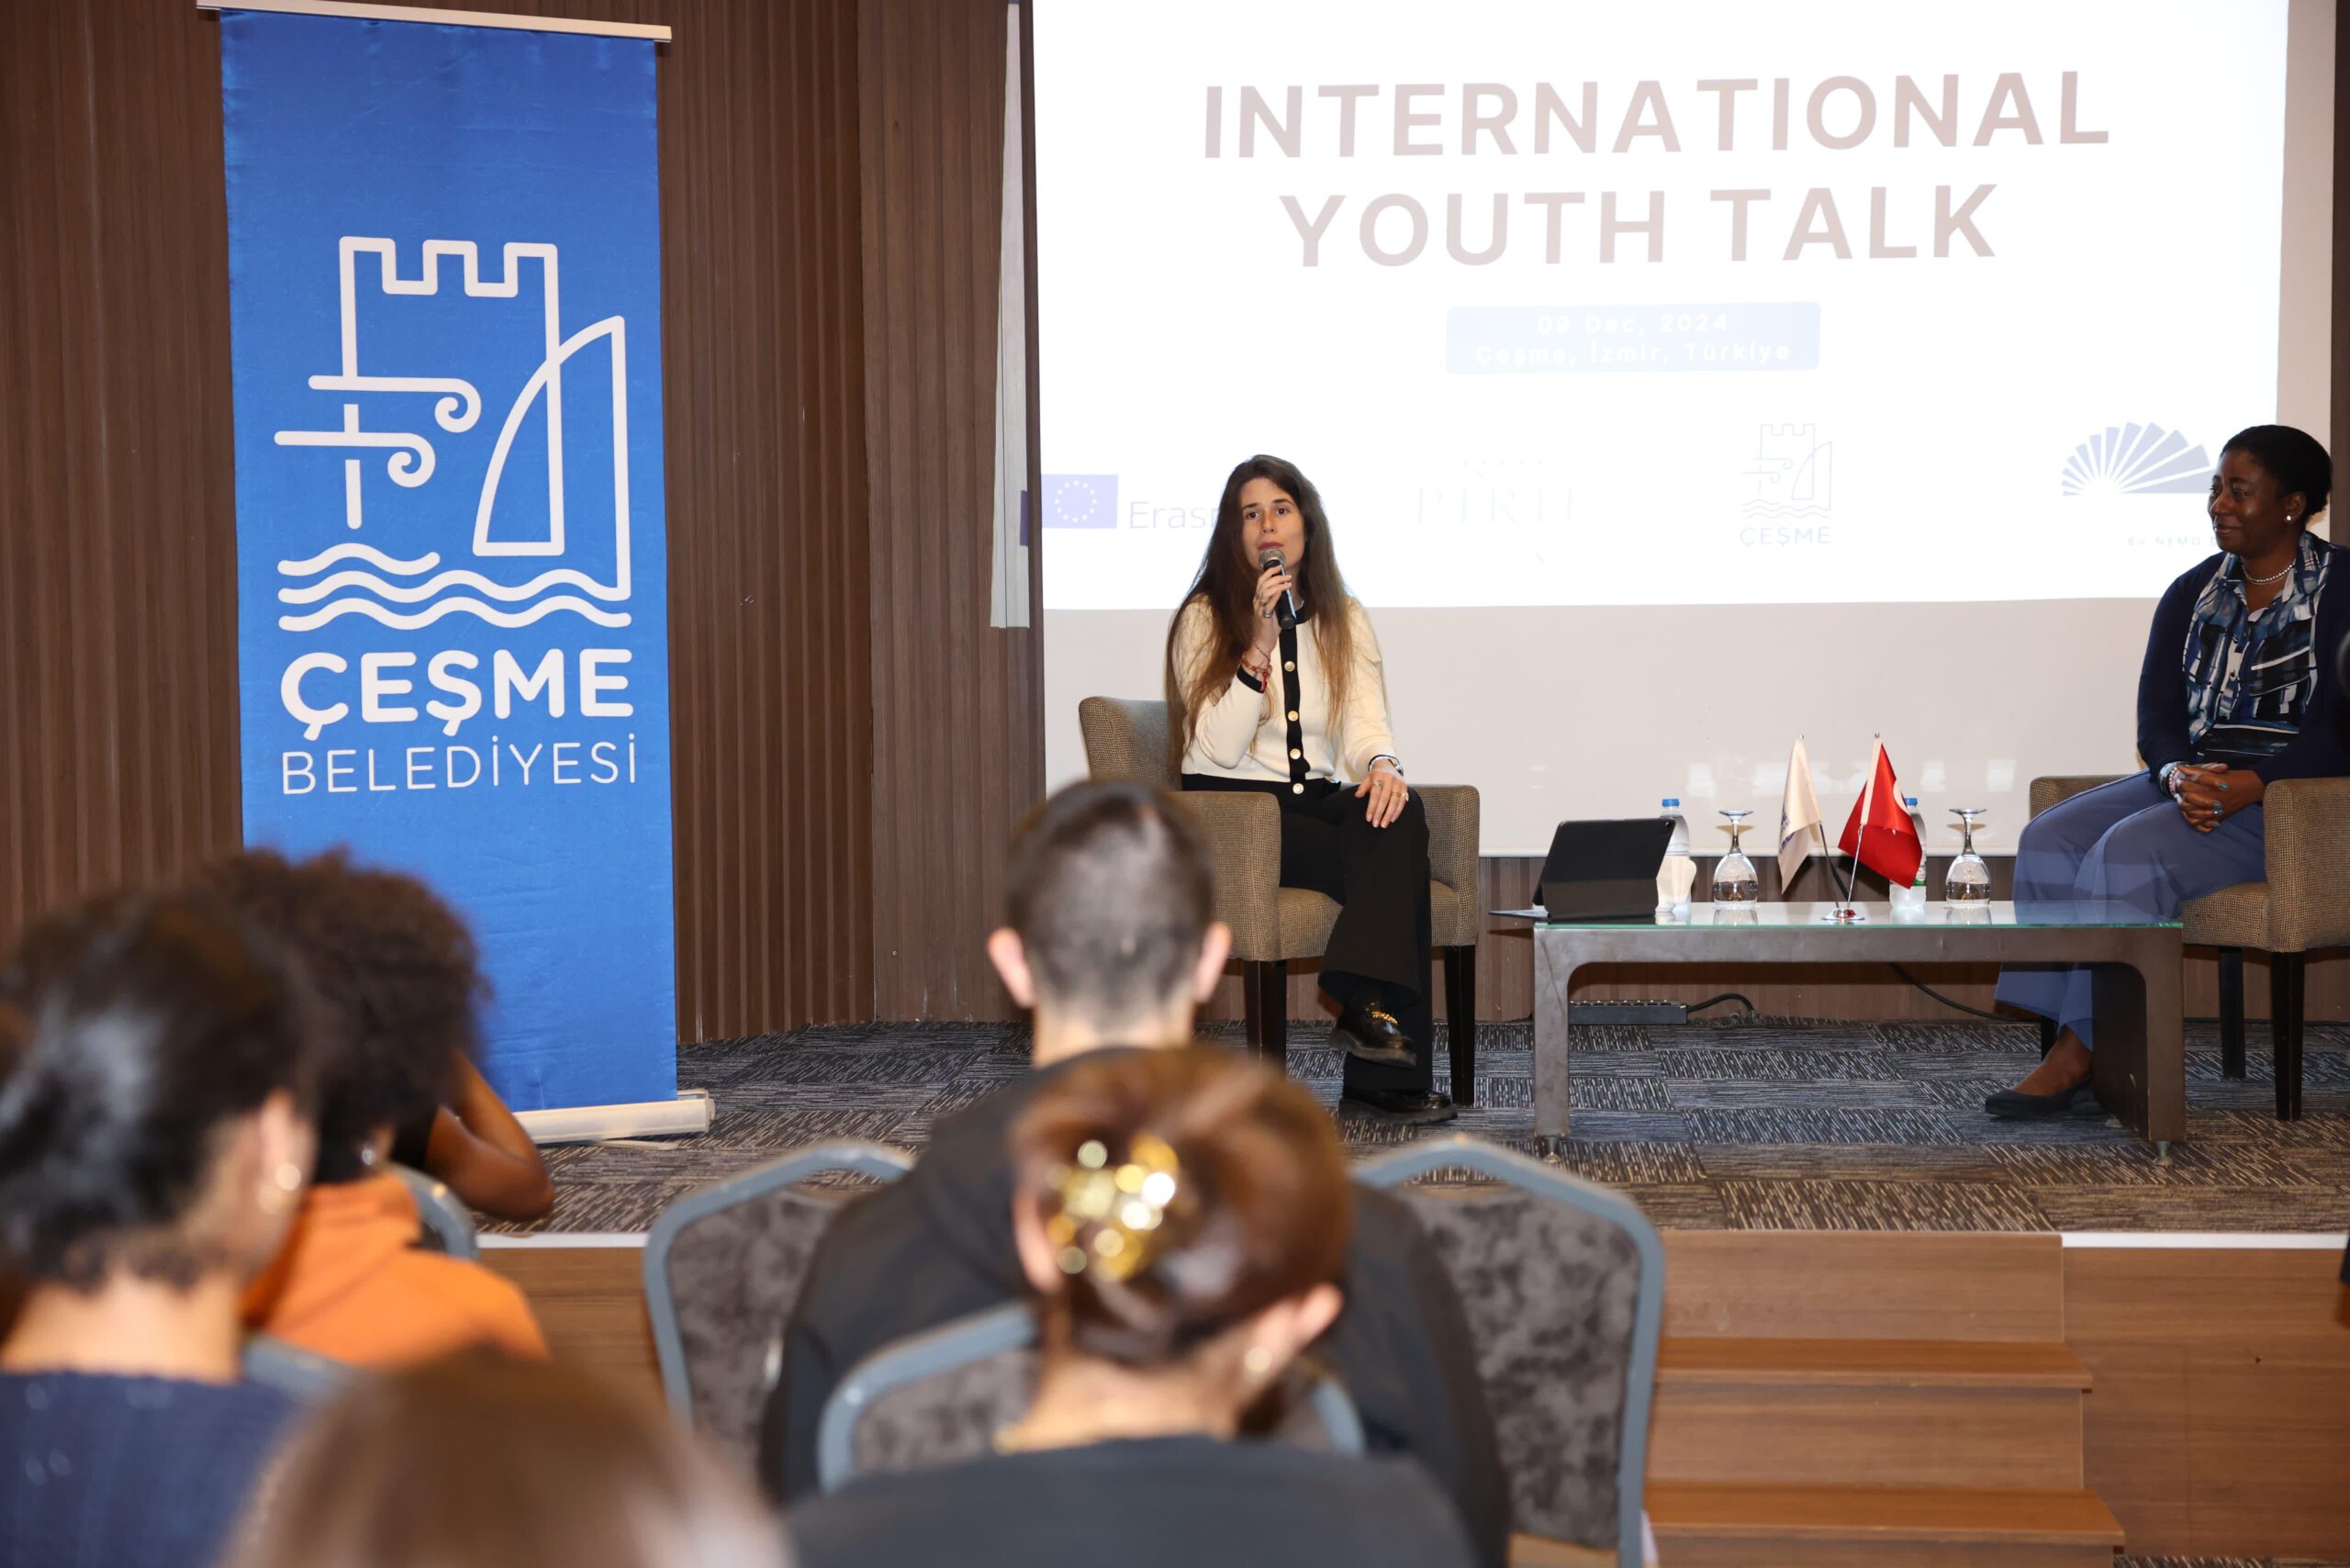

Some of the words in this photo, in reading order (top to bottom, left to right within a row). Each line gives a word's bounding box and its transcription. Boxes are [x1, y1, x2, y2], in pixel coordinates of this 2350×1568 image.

[1204, 70, 2109, 159] INTERNATIONAL
[1279, 189, 1665, 268] YOUTH
[1709, 183, 1998, 262] TALK
[1584, 315, 1645, 336] Dec,
[1659, 313, 1729, 333] 2024
[1475, 344, 1576, 368] Çeşme,
[1589, 340, 1669, 366] İzmir,
[1684, 341, 1791, 364] Türkiye
[1130, 500, 1218, 529] Eras
[1739, 526, 1832, 549] ÇEŞME
[280, 648, 635, 742] ÇEŞME
[282, 734, 636, 795] BELEDİYESİ
